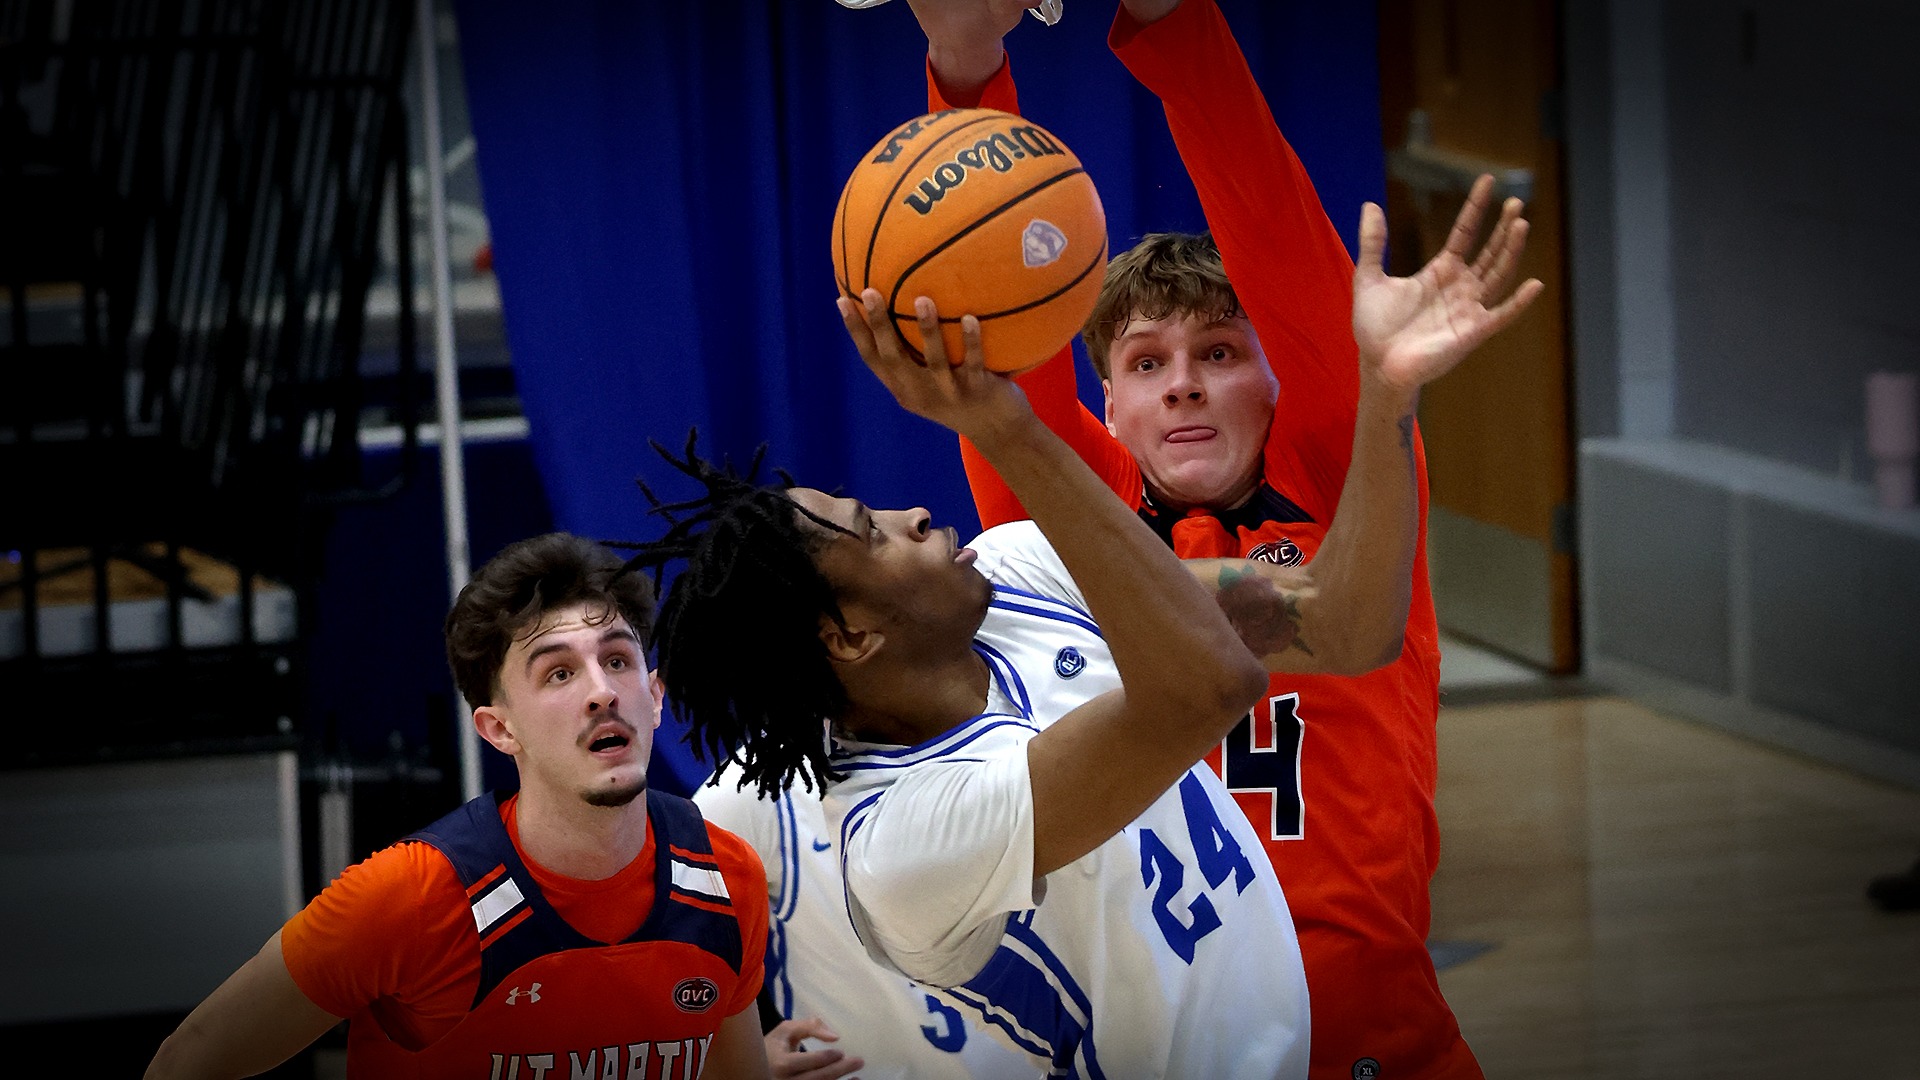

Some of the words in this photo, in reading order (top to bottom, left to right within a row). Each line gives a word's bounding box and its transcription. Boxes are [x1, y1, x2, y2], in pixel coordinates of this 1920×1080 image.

[903, 125, 1067, 216] Wilson
[1221, 692, 1306, 841] 4
[1139, 769, 1257, 966] 24
[681, 988, 711, 1003] OVC
